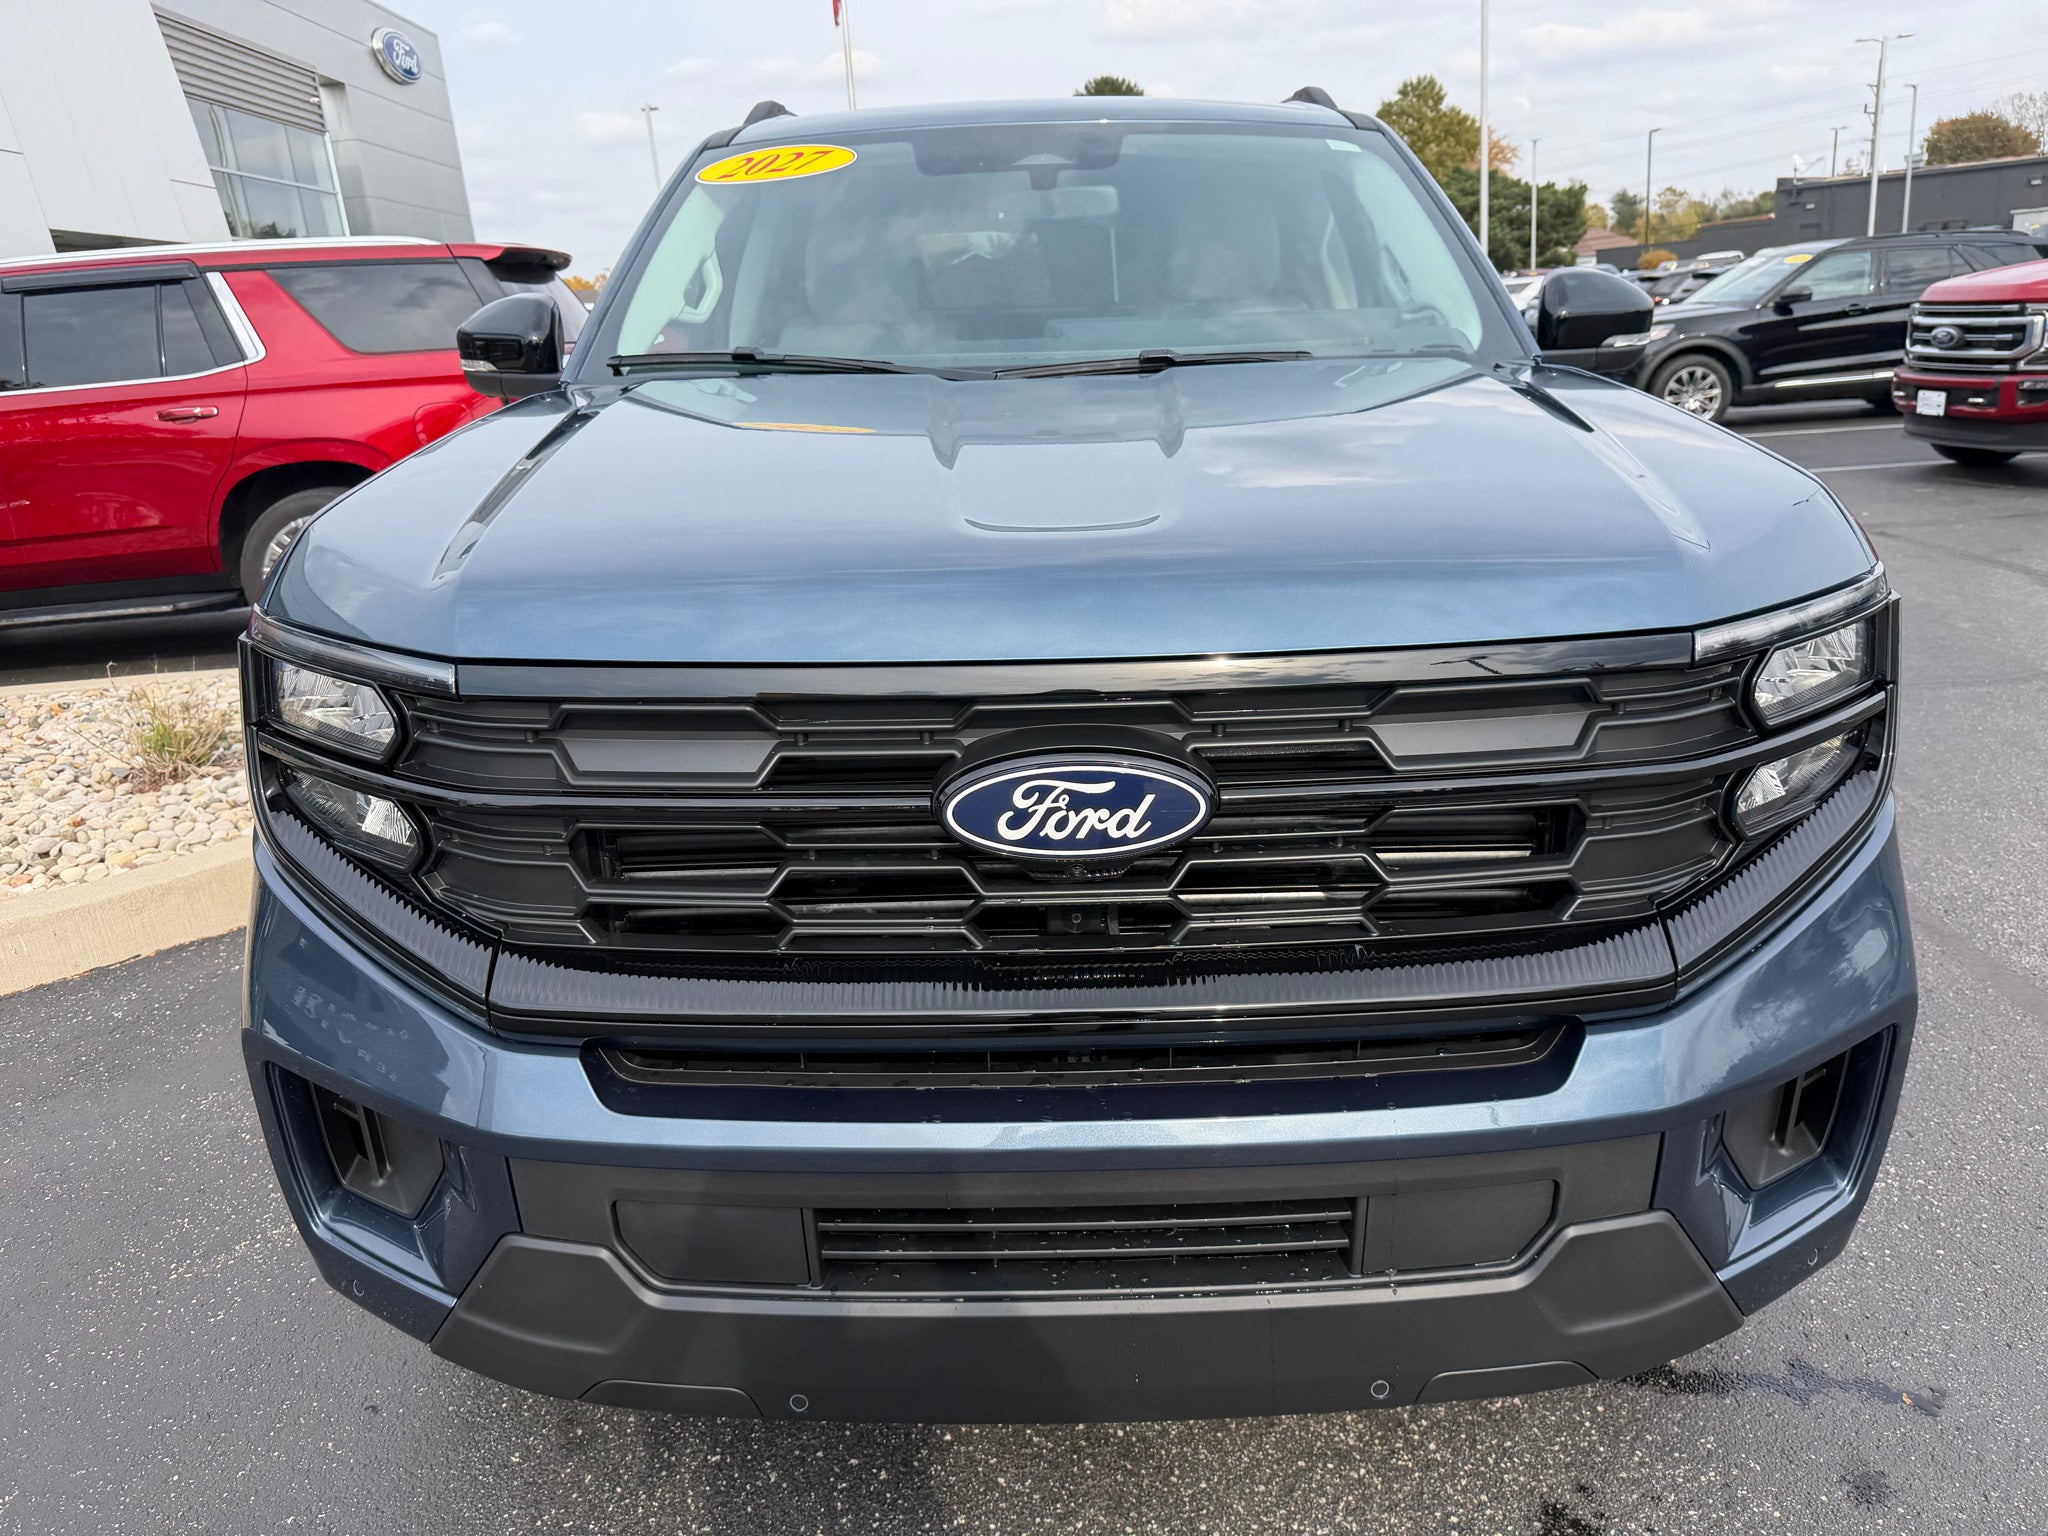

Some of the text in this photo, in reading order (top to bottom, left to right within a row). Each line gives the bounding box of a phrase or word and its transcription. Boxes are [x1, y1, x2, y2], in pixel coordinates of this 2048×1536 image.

[393, 39, 418, 74] Ford
[716, 150, 834, 179] 2027
[997, 779, 1156, 841] Ford
